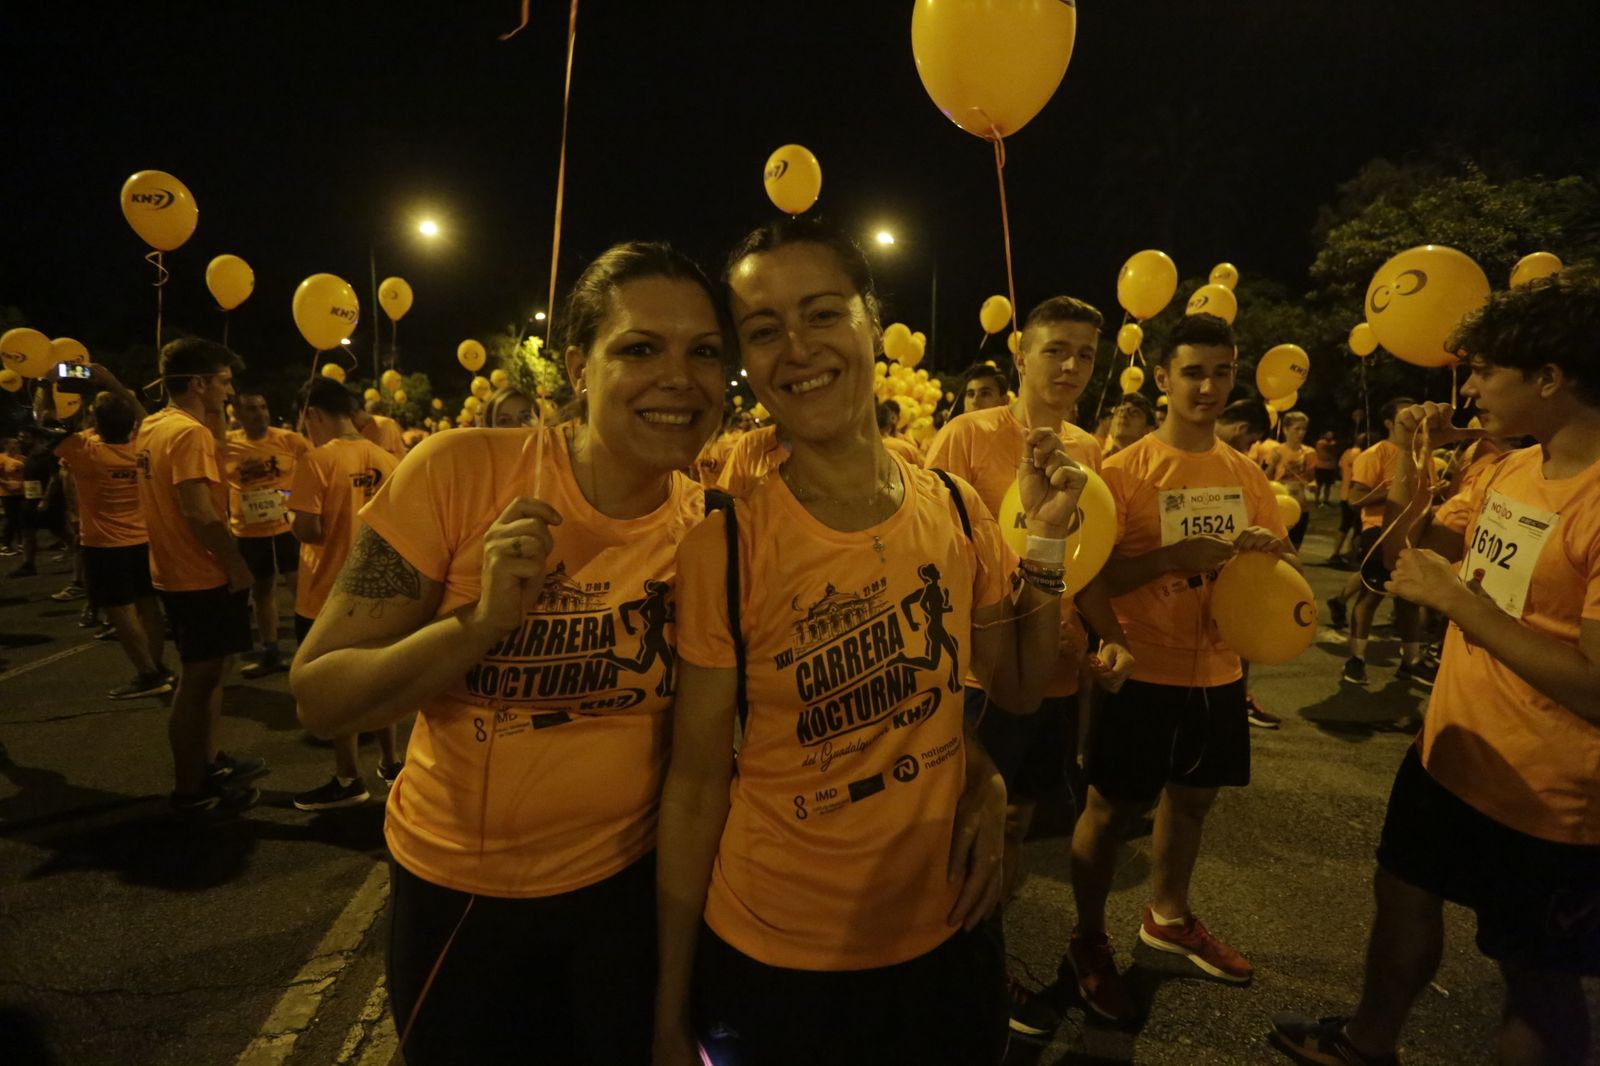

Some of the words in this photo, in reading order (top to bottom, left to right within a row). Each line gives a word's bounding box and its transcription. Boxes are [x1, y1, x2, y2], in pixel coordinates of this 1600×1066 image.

[1181, 514, 1235, 536] 15524
[1471, 525, 1518, 570] 16102
[796, 611, 905, 701] CARRERA
[465, 660, 619, 698] NOCTURNA
[797, 664, 918, 745] NOCTURNA
[815, 788, 838, 801] IMD
